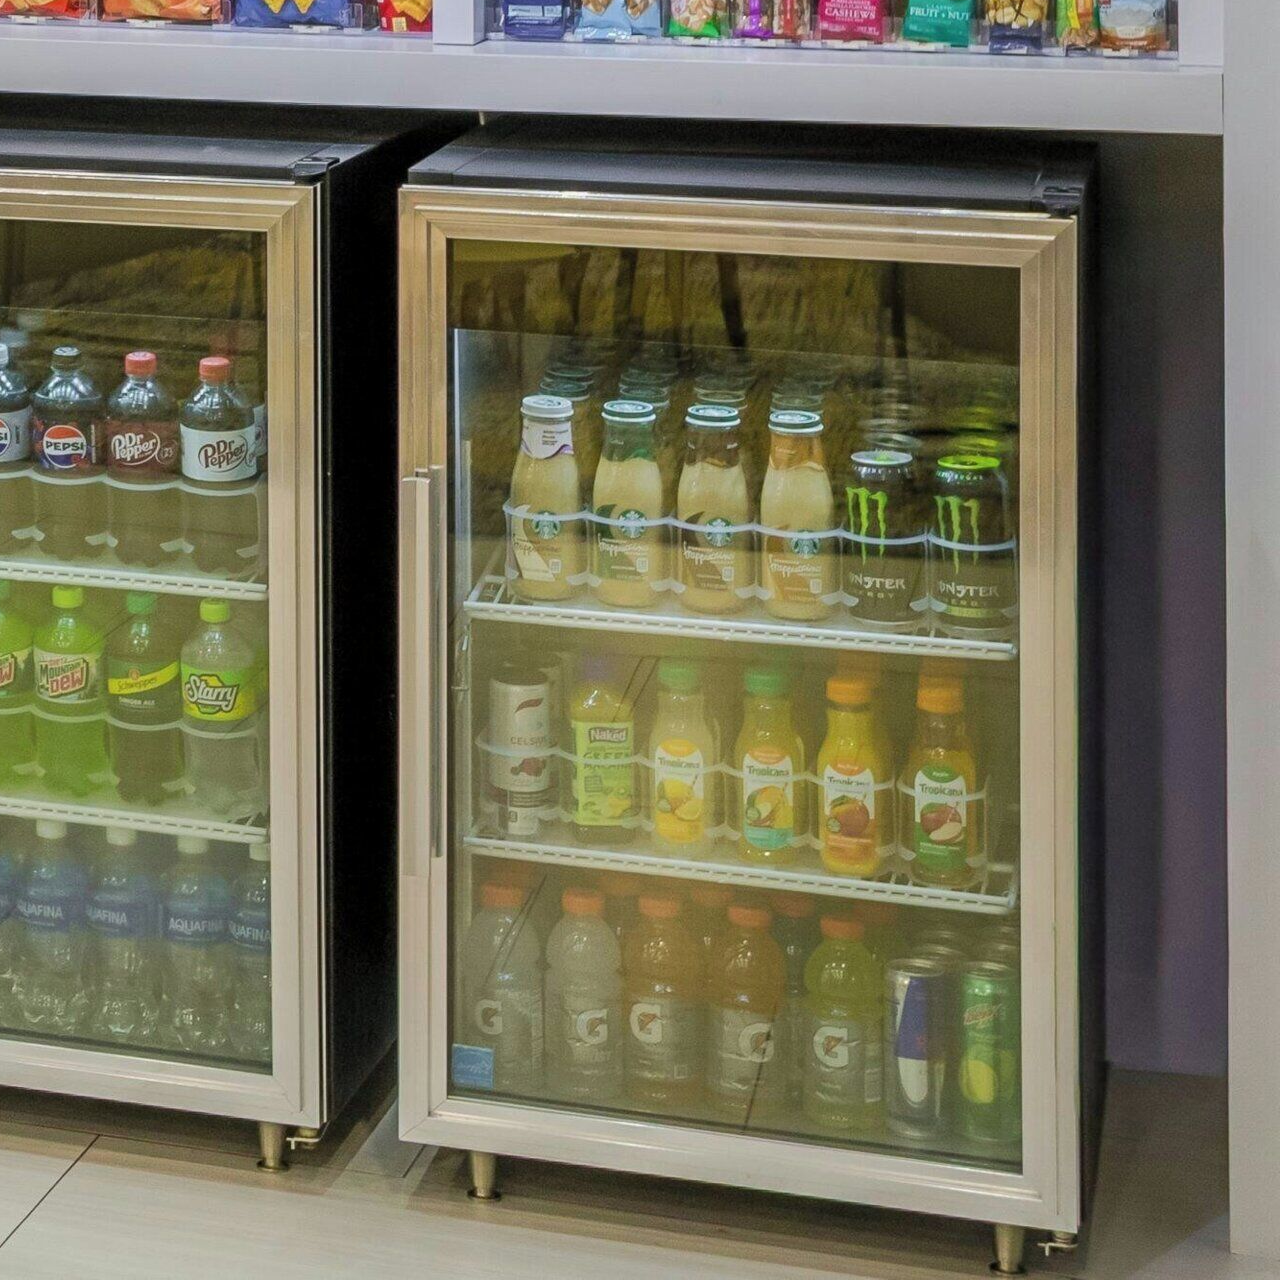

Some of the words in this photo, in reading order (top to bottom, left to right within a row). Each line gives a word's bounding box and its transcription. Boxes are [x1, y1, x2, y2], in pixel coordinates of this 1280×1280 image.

[825, 8, 876, 19] CASHEWS
[910, 6, 939, 18] FRUIT
[45, 440, 85, 452] PEPSI
[125, 432, 144, 447] Dr
[218, 439, 235, 454] Dr
[112, 435, 157, 461] Pepper
[200, 444, 246, 469] Pepper
[940, 581, 1000, 598] ONSTER
[188, 675, 239, 712] Starry
[589, 727, 628, 743] Naked
[747, 765, 790, 777] Tropicana
[919, 783, 963, 797] Tropicana
